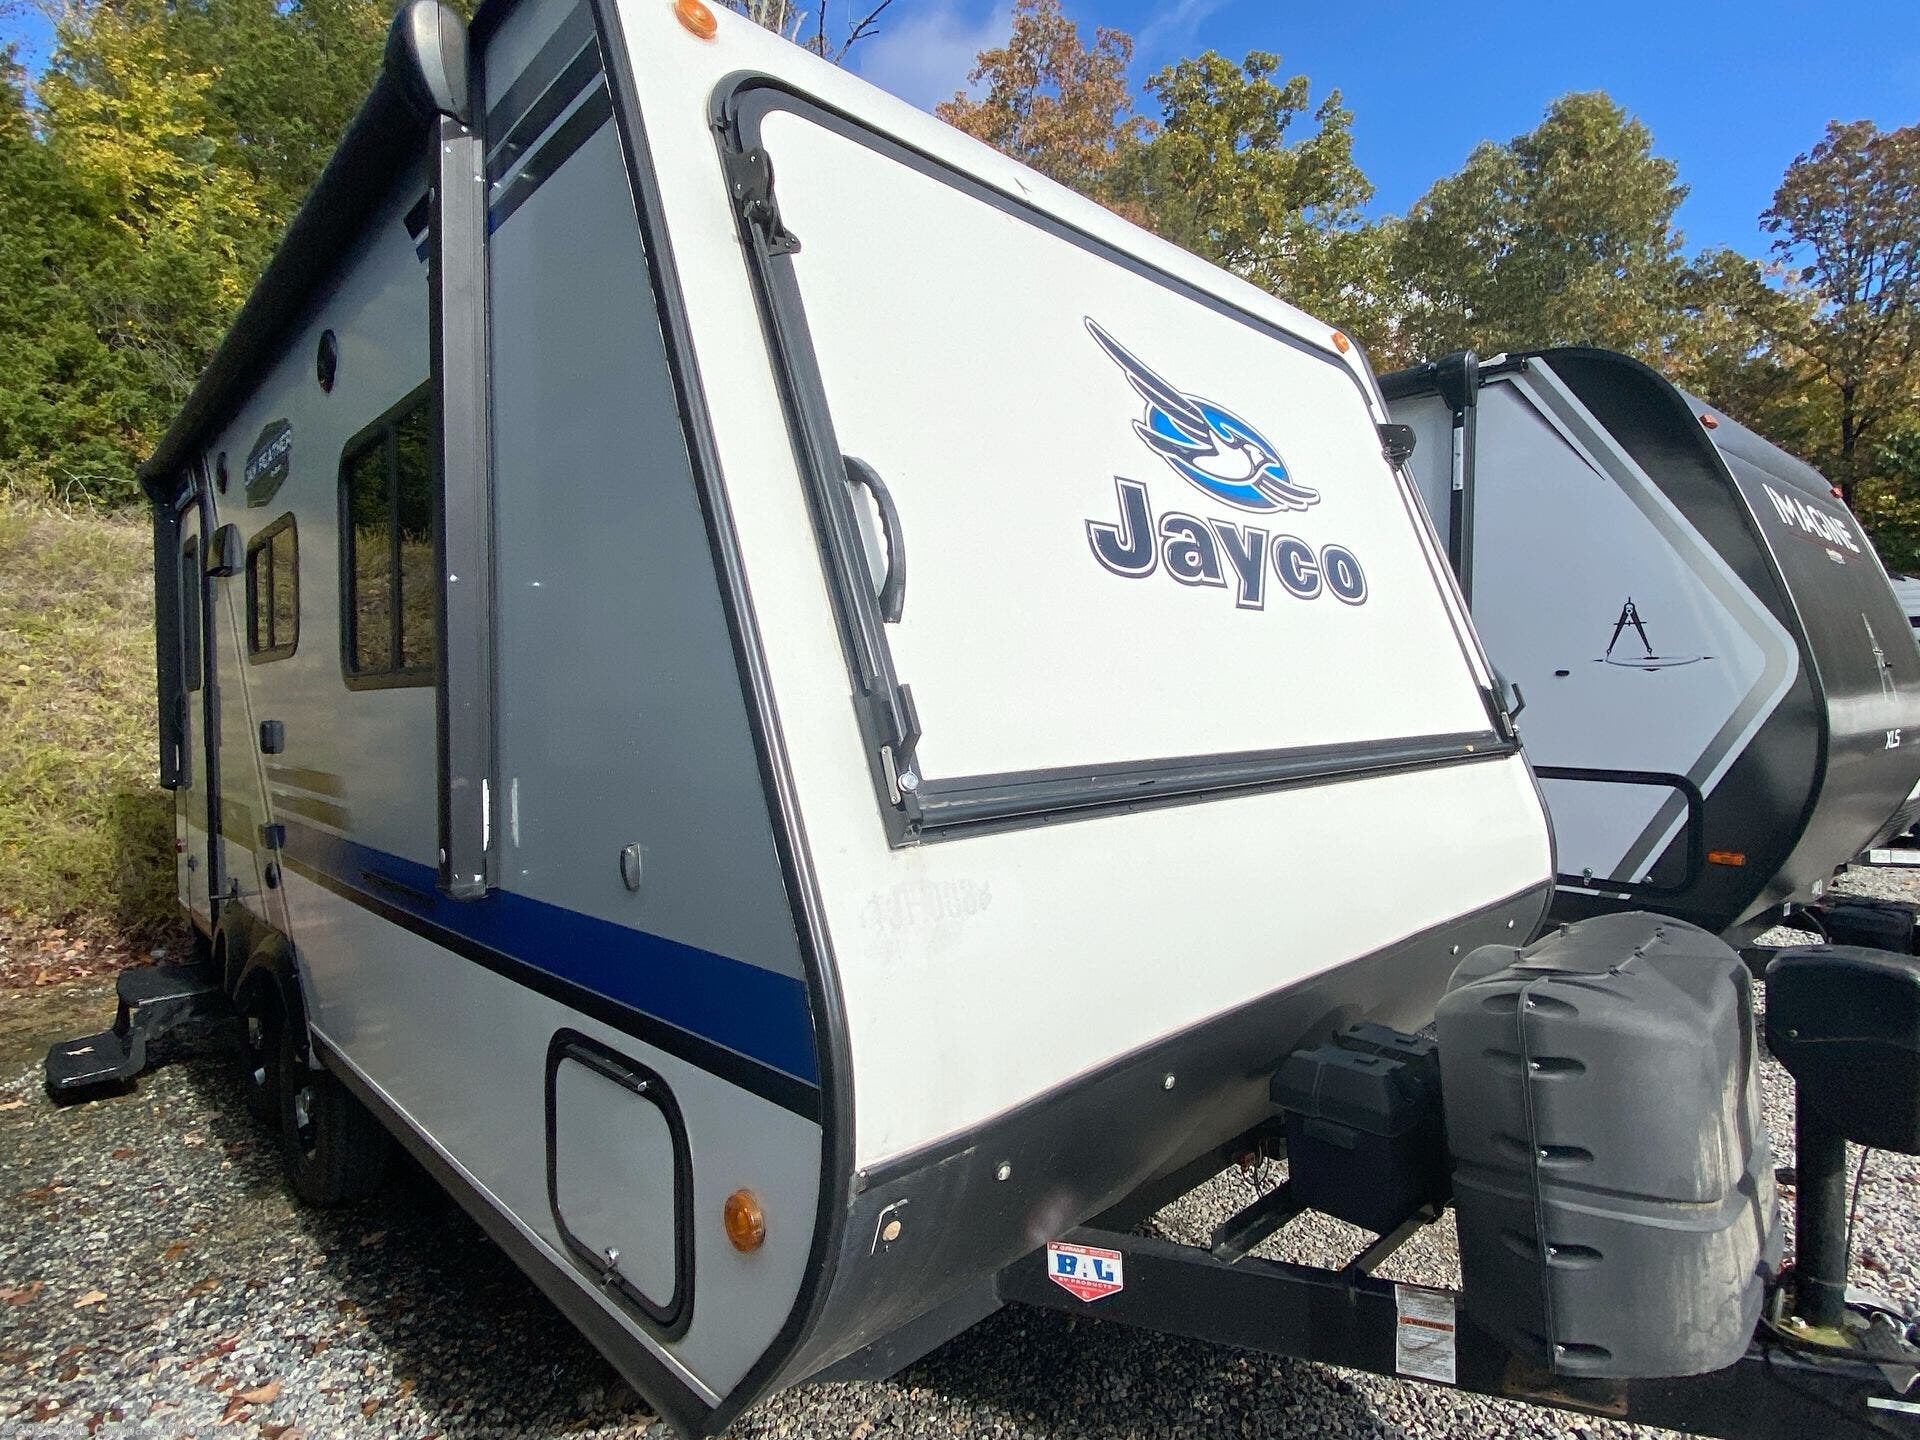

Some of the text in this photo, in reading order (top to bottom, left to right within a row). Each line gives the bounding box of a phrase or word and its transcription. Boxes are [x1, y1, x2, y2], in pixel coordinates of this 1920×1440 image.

[1762, 483, 1860, 553] IMAGINE
[1085, 475, 1369, 611] Jayco
[1885, 729, 1902, 750] XLS
[1056, 1253, 1114, 1282] BAL
[1071, 1279, 1113, 1290] PRODUCTS
